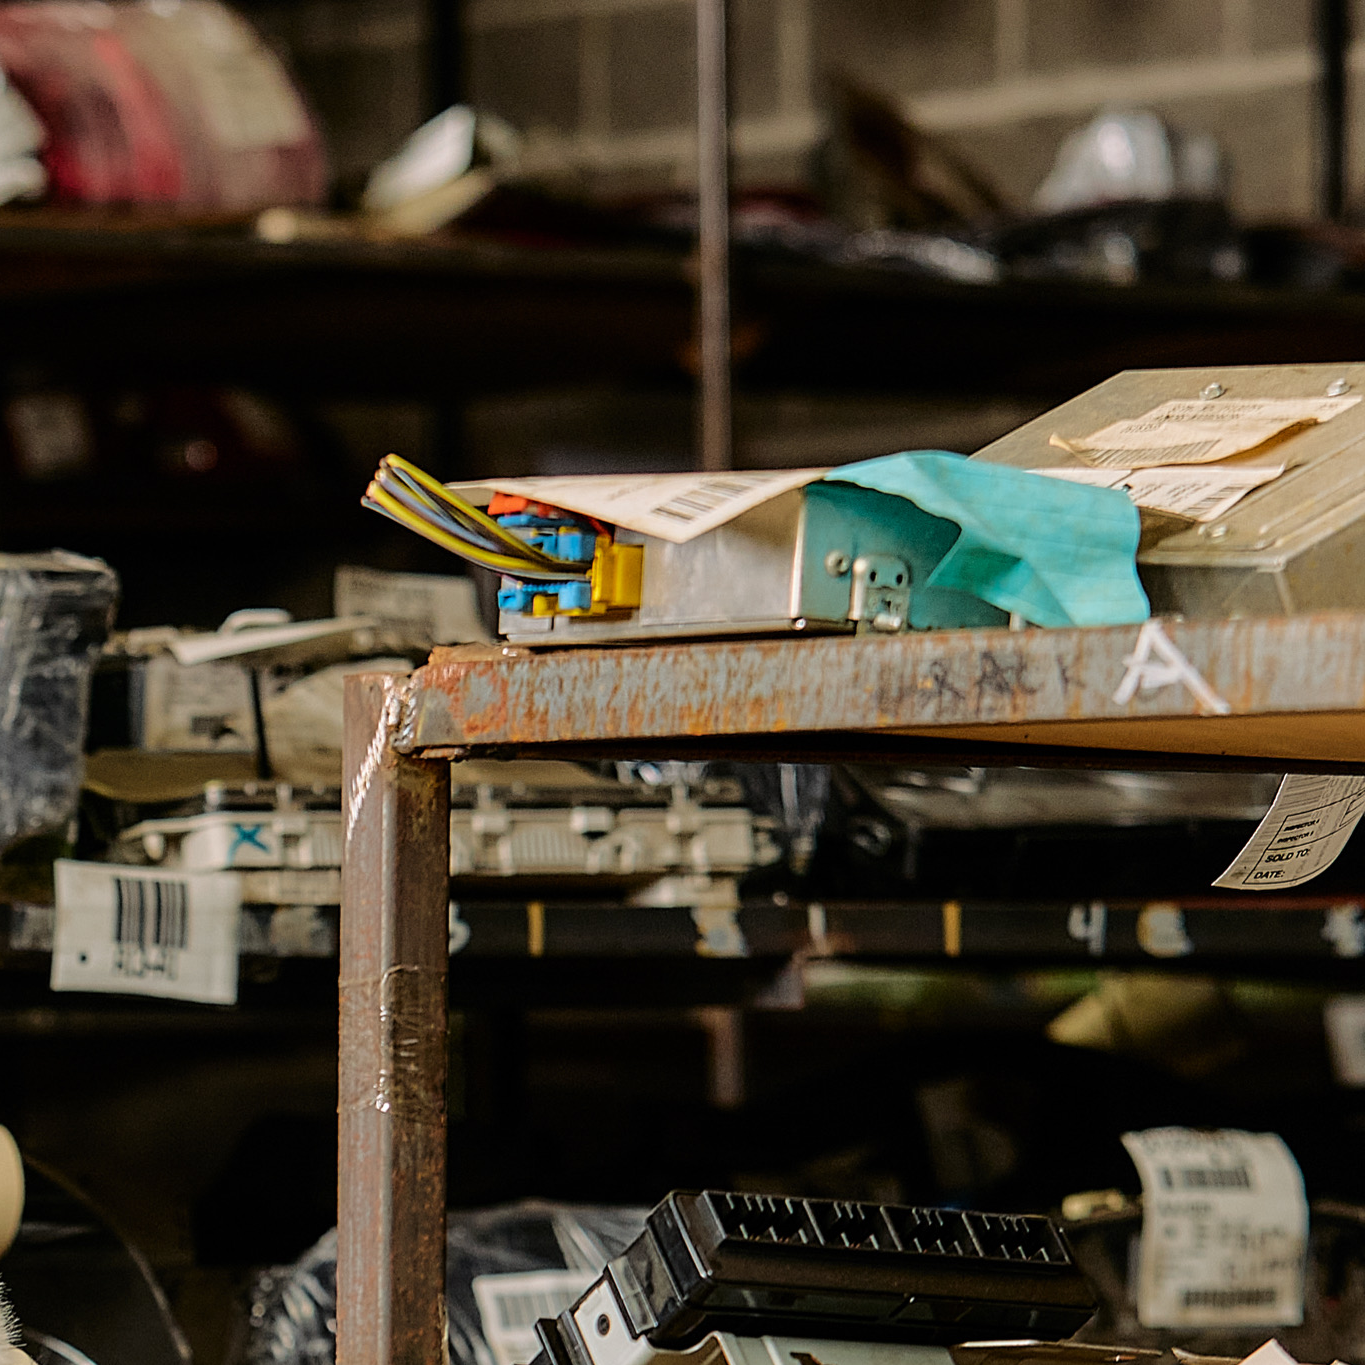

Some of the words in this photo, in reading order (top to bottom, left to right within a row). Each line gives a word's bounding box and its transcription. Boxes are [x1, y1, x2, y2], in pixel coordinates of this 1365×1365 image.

[1112, 619, 1232, 716] A
[1265, 852, 1293, 863] SOLD
[1295, 848, 1311, 858] TO:
[1253, 870, 1285, 880] DATE:
